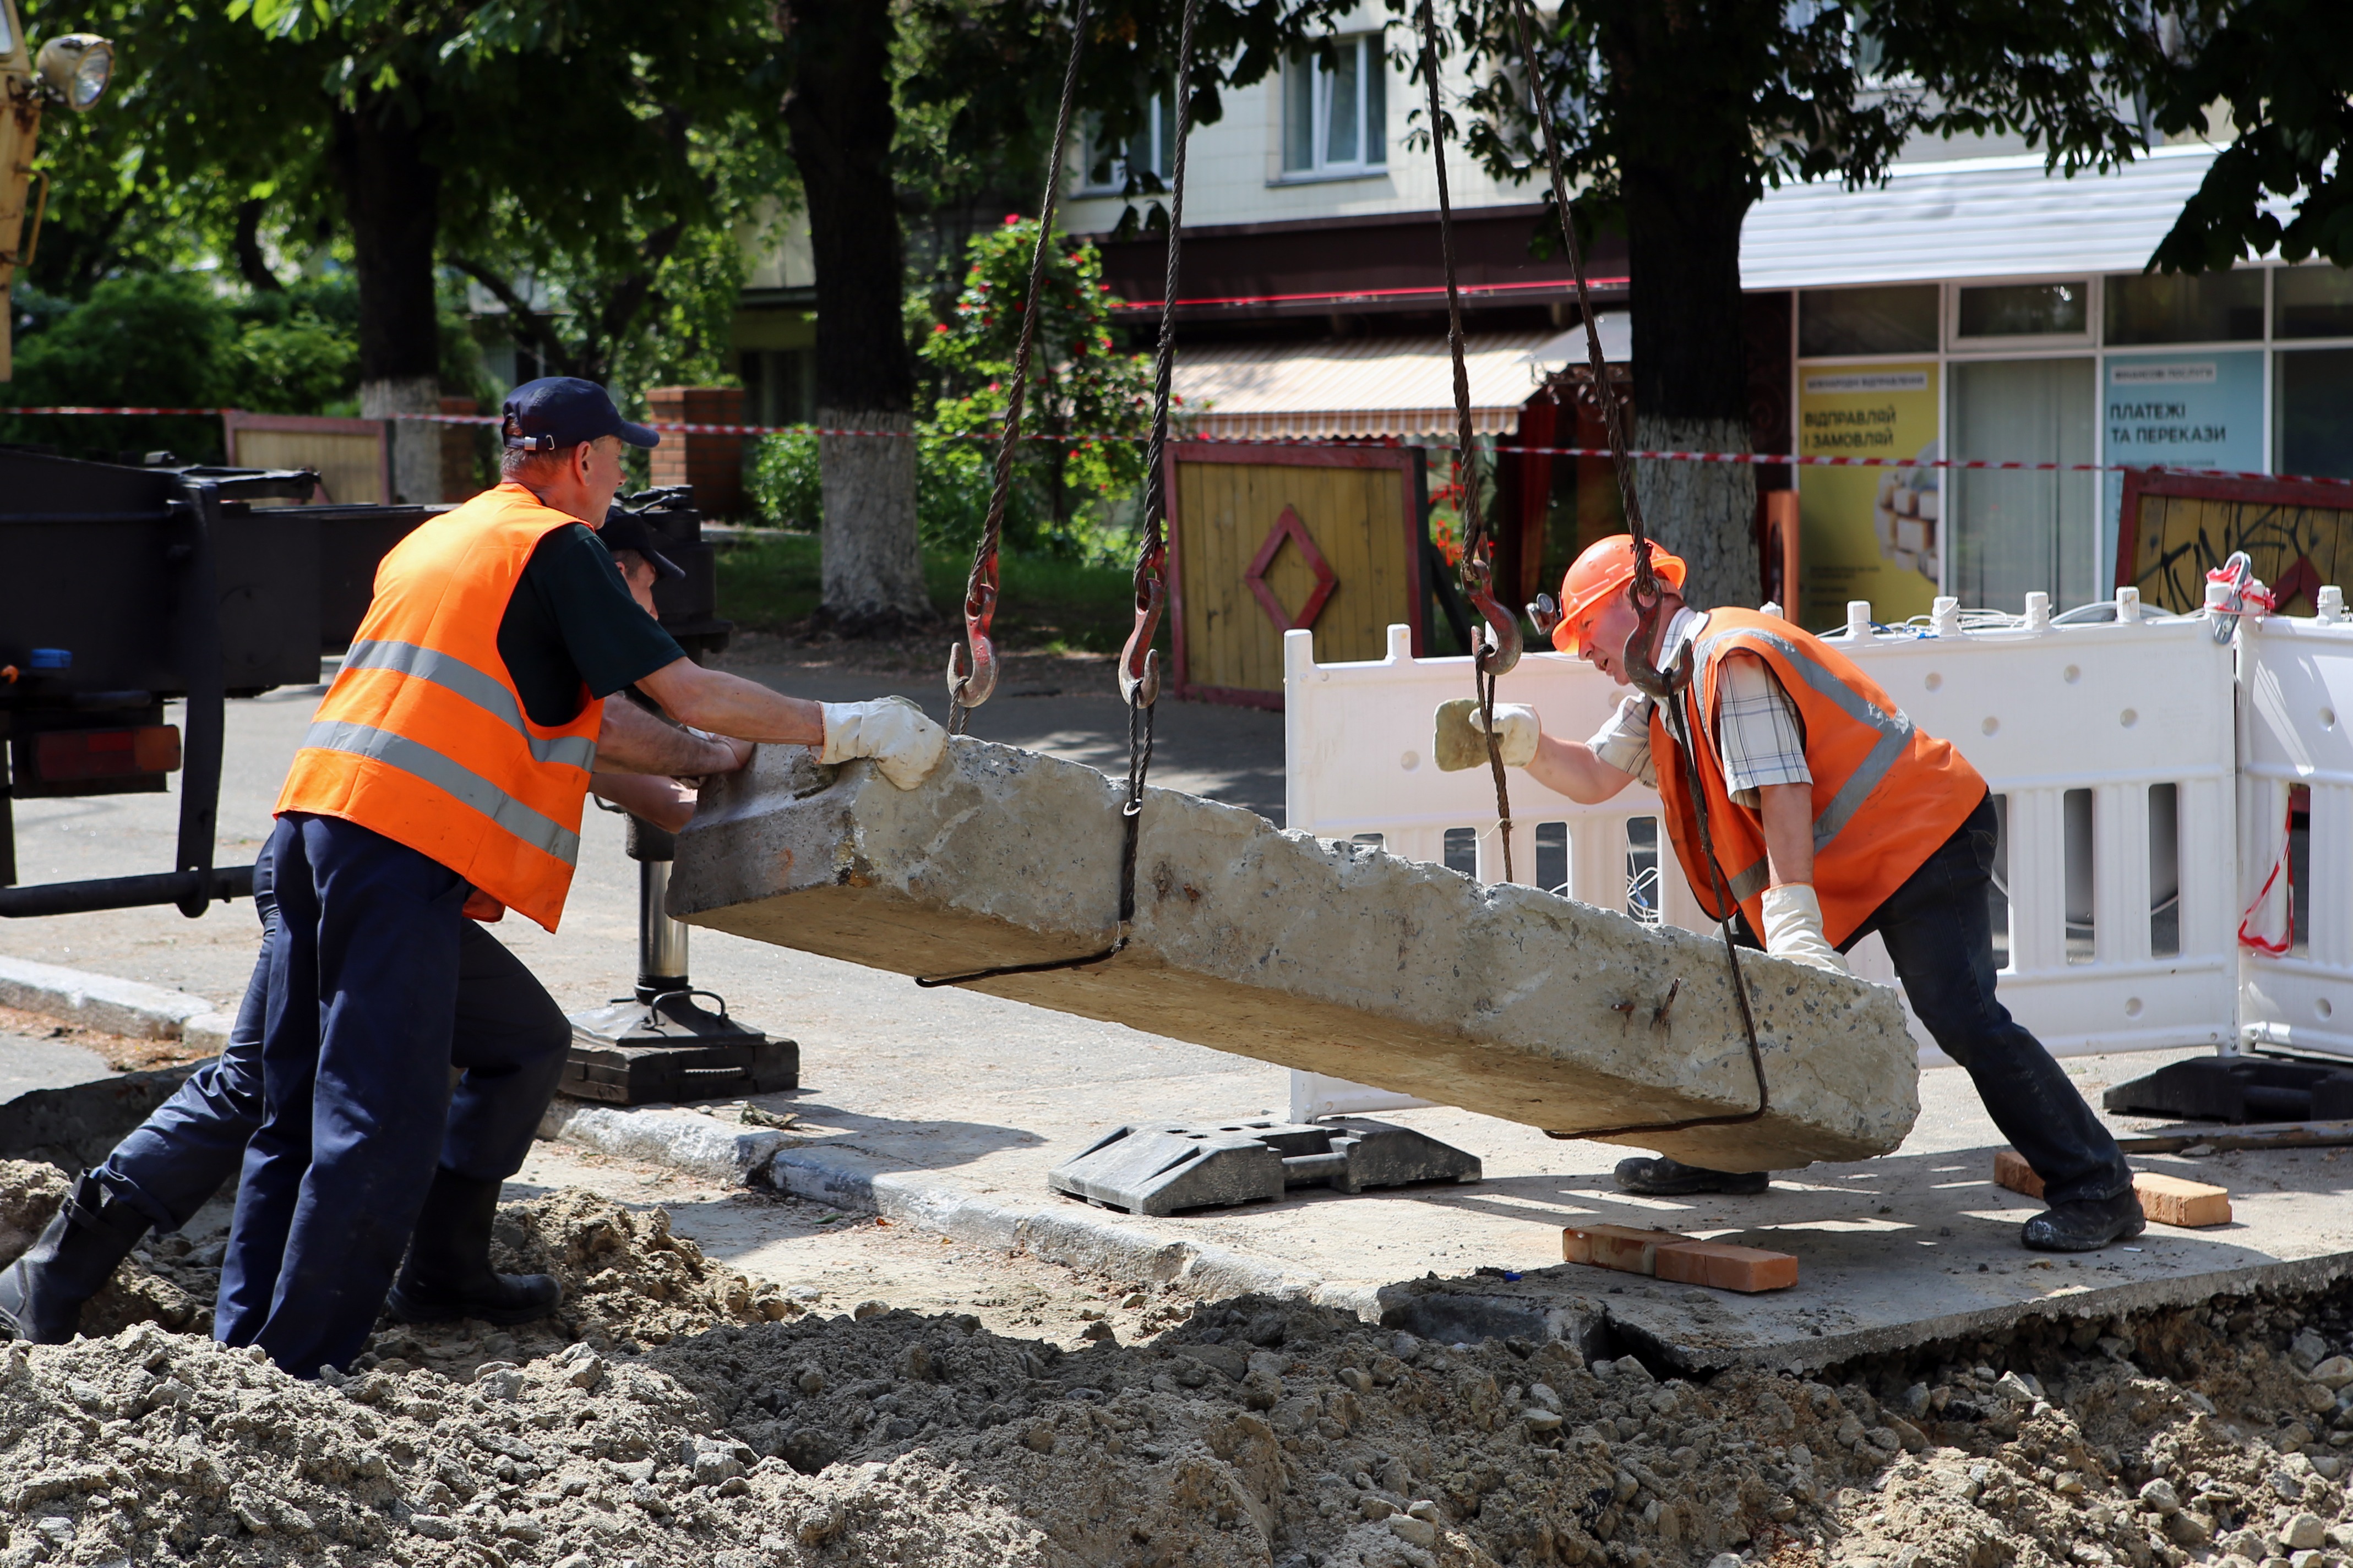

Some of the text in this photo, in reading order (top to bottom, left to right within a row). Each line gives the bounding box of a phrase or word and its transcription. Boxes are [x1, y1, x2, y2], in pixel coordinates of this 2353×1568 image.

[1804, 404, 1897, 428] ВІДПРАВЛЯЙ
[2110, 401, 2186, 420] ПЛАТЕЖІ
[1804, 426, 1894, 449] І ЗАМОВЛЯЙ
[2111, 425, 2226, 444] ТА ПЕРЕКАЗИ
